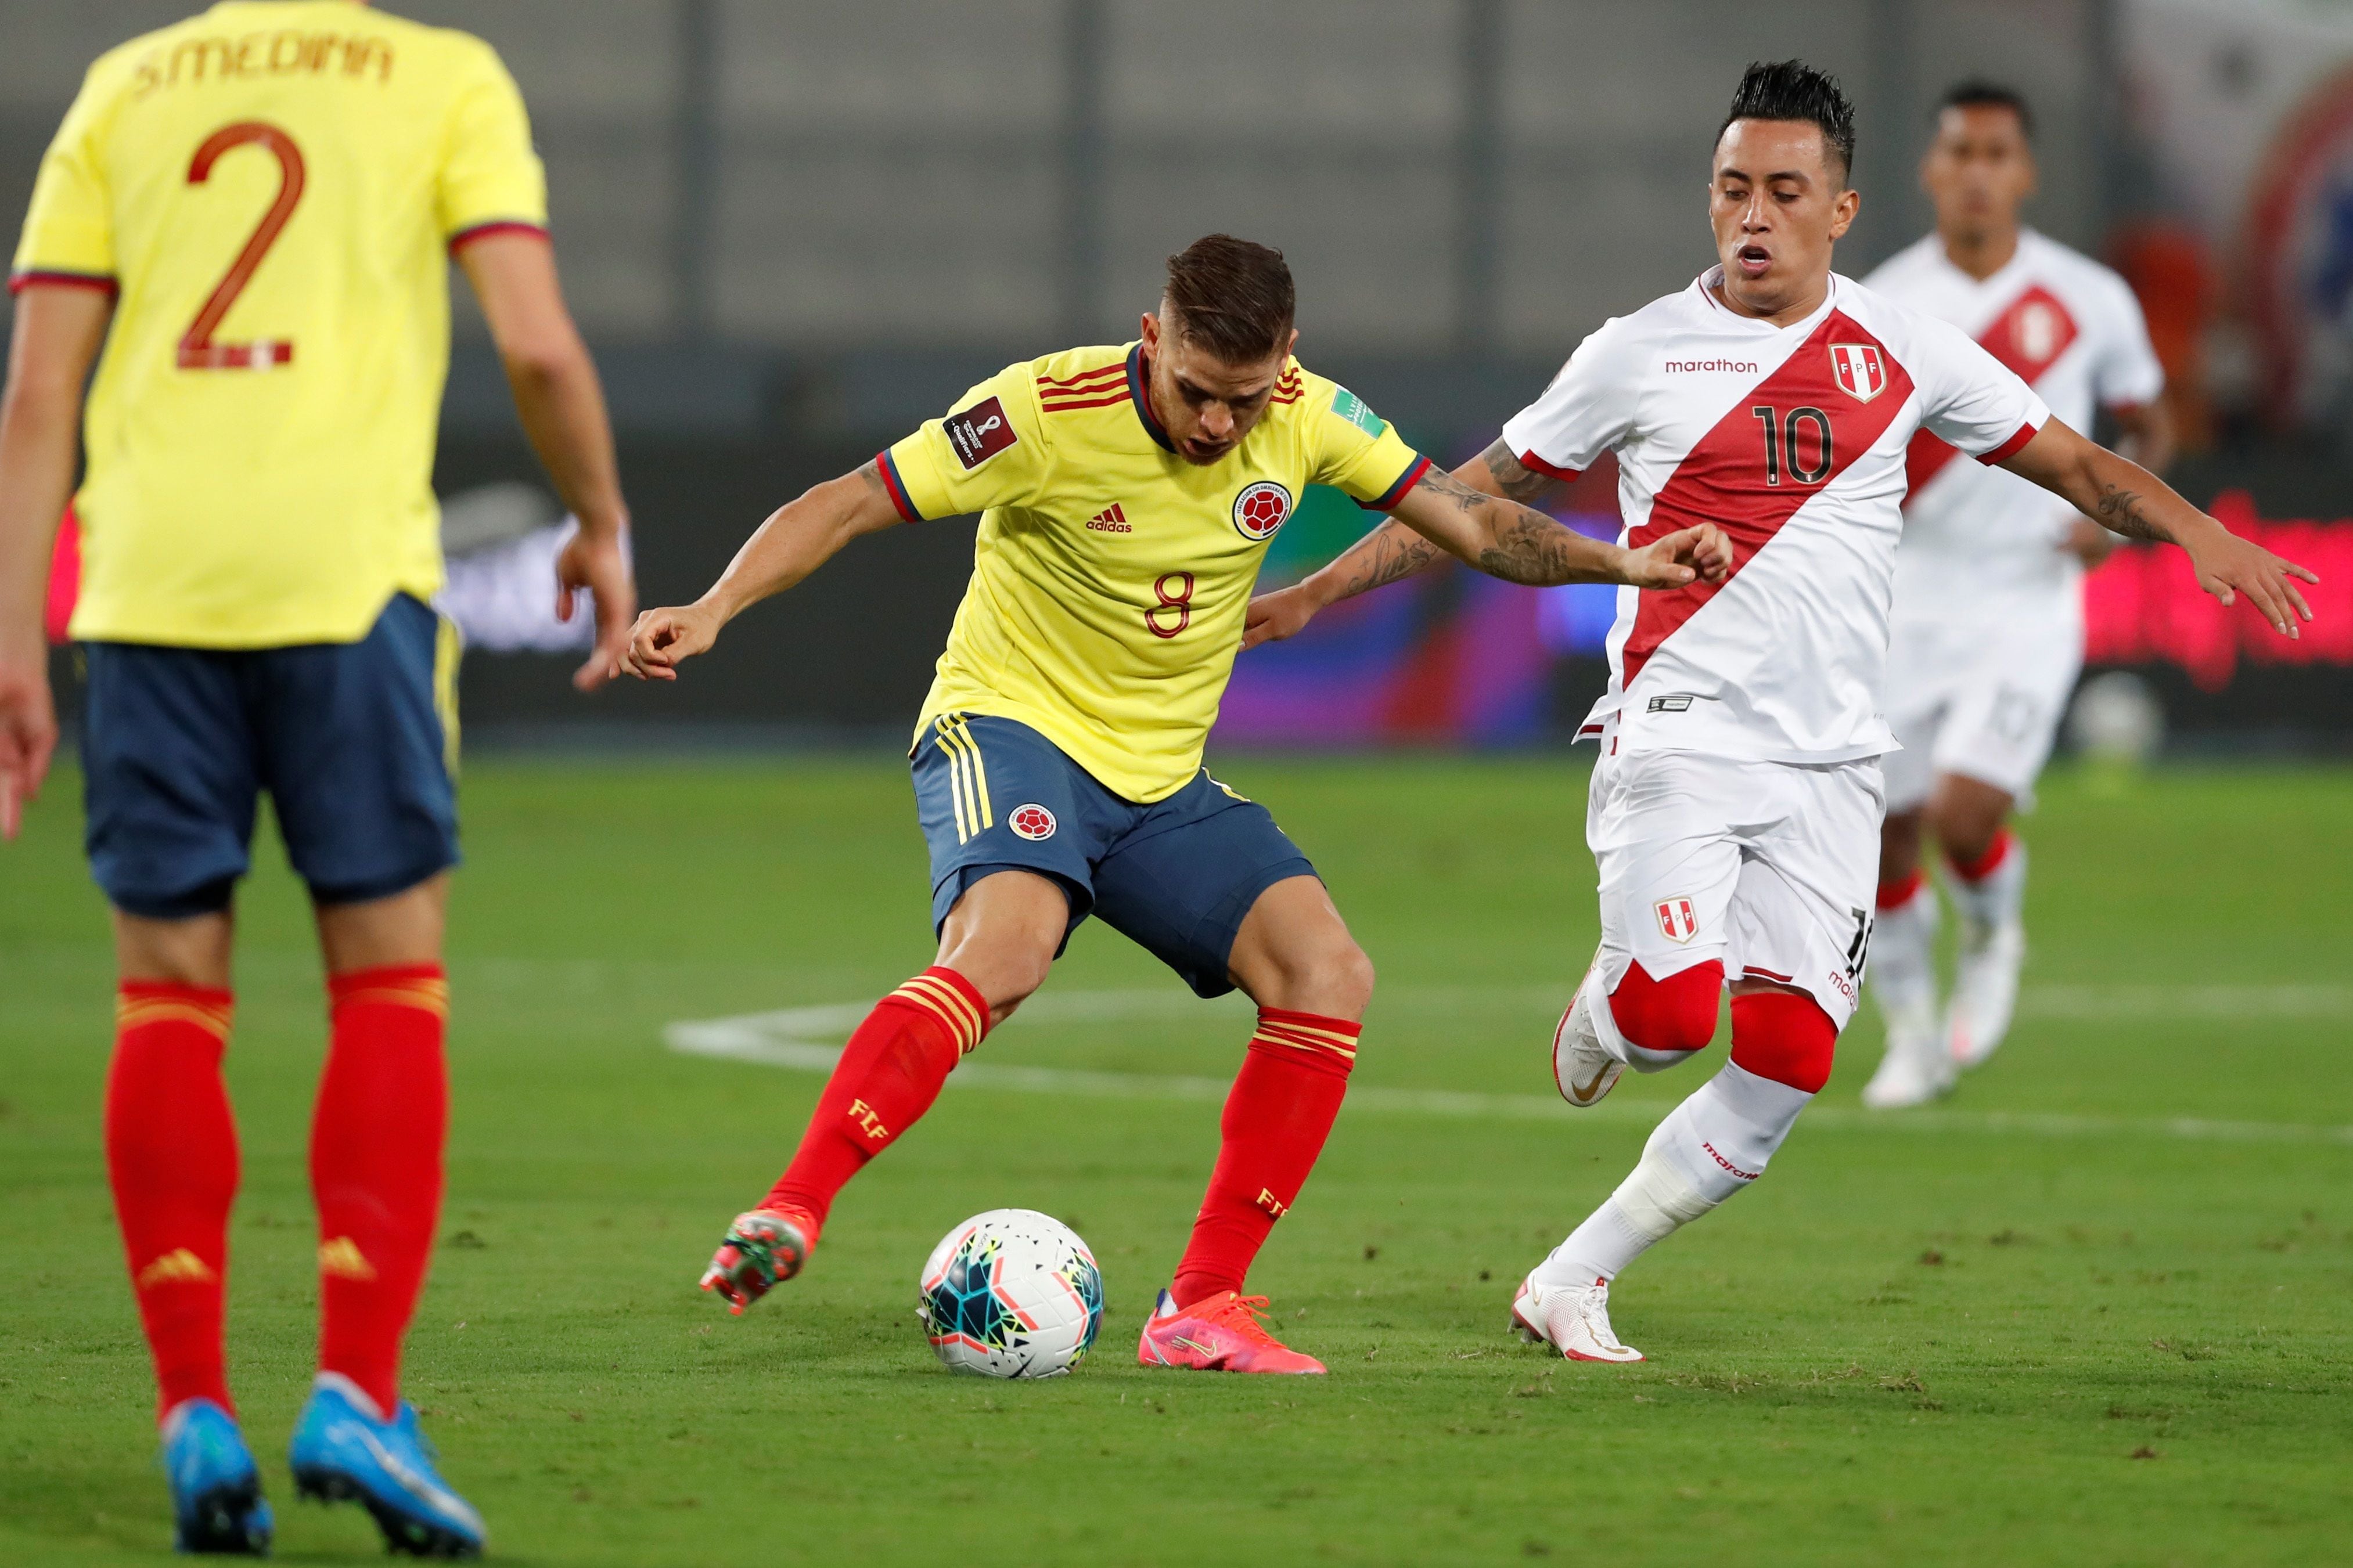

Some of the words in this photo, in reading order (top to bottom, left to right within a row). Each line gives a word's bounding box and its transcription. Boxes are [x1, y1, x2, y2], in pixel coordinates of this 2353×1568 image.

[177, 120, 307, 370] 2
[1665, 359, 1758, 373] marathon
[954, 425, 973, 458] Qualifiers
[1752, 406, 1833, 487] 10
[1085, 521, 1132, 533] adidas
[1144, 571, 1195, 639] 8
